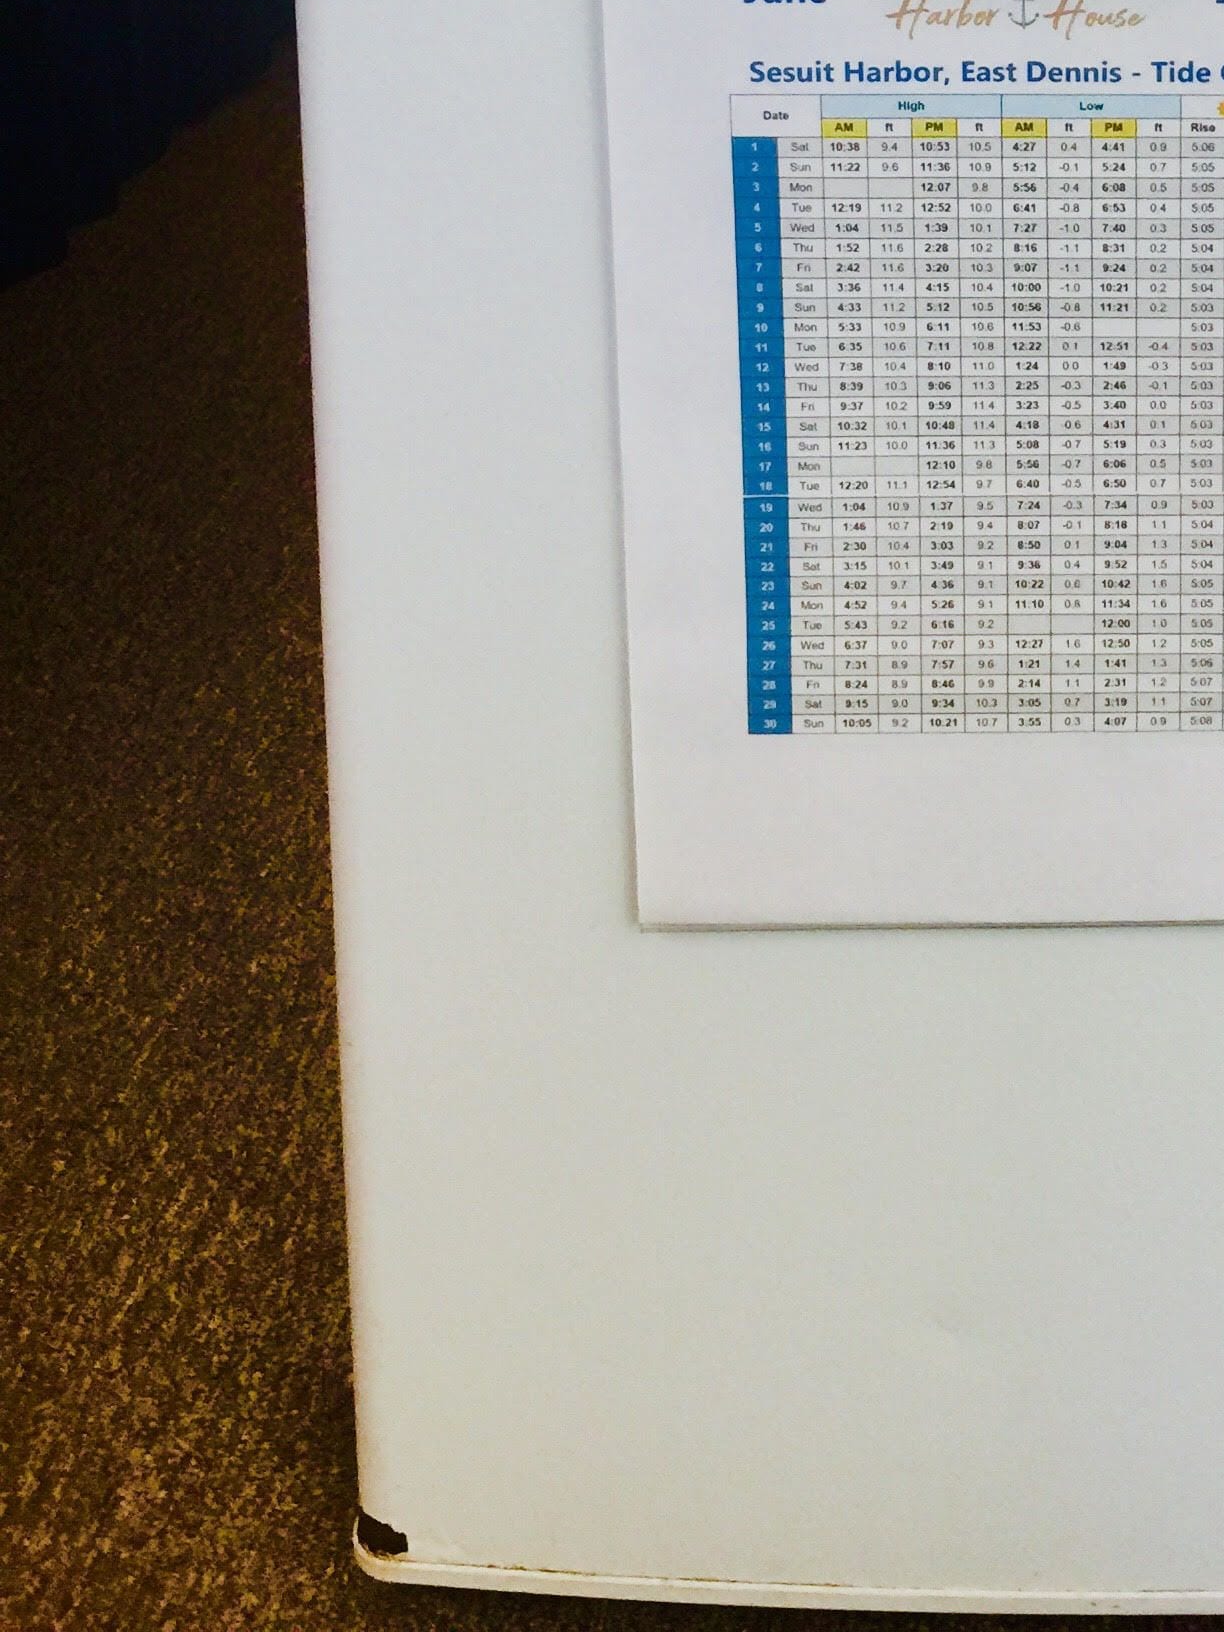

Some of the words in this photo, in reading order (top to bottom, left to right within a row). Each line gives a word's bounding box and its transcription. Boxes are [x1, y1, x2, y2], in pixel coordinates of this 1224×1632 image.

[750, 60, 834, 83] Sesuit
[844, 60, 950, 86] Harbor,
[962, 61, 1017, 83] East
[1027, 61, 1122, 84] Dennis
[1151, 61, 1211, 84] Tide
[897, 100, 925, 112] High
[1079, 101, 1105, 112] Low
[763, 111, 790, 121] Date
[834, 122, 854, 132] AM
[925, 122, 944, 132] PM
[1014, 122, 1034, 132] AM
[1104, 122, 1123, 132] PM
[1190, 122, 1216, 132] Rise
[750, 141, 758, 152] 1
[830, 141, 861, 152] 10:38
[919, 141, 950, 152] 10:53
[1012, 141, 1037, 152] 4:27
[1101, 142, 1125, 152] 4:41
[751, 161, 760, 173] 2
[789, 161, 812, 173] Sun
[830, 162, 861, 172] 11:22
[920, 162, 951, 172] 11:36
[1012, 162, 1037, 173] 5:12
[1102, 162, 1126, 172] 5:24
[789, 182, 813, 193] Mon
[1101, 182, 1126, 193] 6:08
[791, 202, 813, 213] Tue
[831, 202, 862, 213] 12:19
[921, 202, 952, 213] 12:52
[1012, 203, 1036, 213] 6:41
[1101, 202, 1126, 213] 6:53
[753, 222, 762, 233] 5
[789, 223, 815, 233] Wed
[835, 223, 860, 233] 1:04
[924, 222, 949, 233] 1:39
[1013, 223, 1038, 233] 7:27
[1102, 223, 1127, 233] 7:40
[792, 242, 814, 253] Thu
[836, 242, 860, 253] 1:52
[924, 242, 949, 253] 2:28
[1013, 242, 1038, 253] 8:16
[1102, 243, 1125, 253] 8:31
[835, 262, 861, 273] 2:42
[925, 262, 950, 273] 3:20
[1013, 262, 1038, 273] 9:07
[1102, 263, 1127, 273] 9:24
[837, 282, 862, 293] 3:36
[925, 282, 950, 293] 4:15
[1011, 282, 1042, 293] 10:00
[1099, 282, 1129, 293] 10:21
[794, 302, 816, 313] Sun
[837, 302, 862, 313] 4:33
[926, 302, 950, 312] 5:12
[1100, 302, 1129, 313] 11:21
[754, 322, 769, 333] 10
[793, 322, 818, 333] Mon
[837, 322, 862, 332] 5:33
[926, 322, 950, 332] 6:11
[1012, 321, 1042, 332] 11:53
[927, 341, 950, 351] 7:11
[1099, 341, 1129, 352] 12:51
[755, 362, 770, 373] 12
[793, 362, 820, 372] Wed
[839, 361, 863, 372] 7:38
[927, 361, 952, 371] 8:10
[1103, 361, 1127, 371] 1:49
[839, 381, 864, 392] 8:39
[927, 380, 952, 391] 9:06
[1015, 380, 1040, 391] 2:25
[1103, 380, 1127, 391] 2:46
[839, 401, 864, 411] 9:37
[927, 400, 952, 411] 9:59
[1015, 400, 1040, 410] 3:23
[1103, 400, 1127, 410] 3:40
[799, 422, 818, 432] Sat
[837, 420, 868, 431] 10:32
[925, 420, 956, 430] 10:48
[1015, 420, 1040, 430] 4:18
[838, 441, 868, 451] 11:23
[1016, 439, 1040, 450] 5:08
[1103, 439, 1127, 449] 5:19
[926, 460, 956, 470] 12:10
[1102, 459, 1127, 469] 6:06
[839, 480, 869, 491] 12:20
[926, 479, 956, 490] 12:54
[1102, 478, 1127, 489] 6:50
[842, 502, 867, 512] 1:04
[1104, 499, 1128, 510] 7:34
[759, 522, 774, 533] 20
[1017, 520, 1041, 530] 8:07
[930, 540, 955, 551] 3:03
[1103, 539, 1128, 550] 9:04
[843, 560, 868, 571] 3:15
[930, 560, 955, 570] 3:49
[843, 580, 868, 590] 4:02
[1101, 579, 1131, 589] 10:42
[843, 600, 868, 610] 4:52
[1101, 598, 1131, 609] 11:34
[844, 620, 868, 630] 5:43
[844, 640, 868, 650] 6:37
[802, 660, 824, 670] Thu
[932, 659, 955, 670] 7:57
[844, 679, 868, 689] 8:24
[931, 698, 955, 709] 9:34
[1018, 697, 1042, 708] 3:05
[803, 718, 825, 729] Sun
[842, 718, 873, 728] 10:05
[1103, 716, 1127, 726] 4:07
